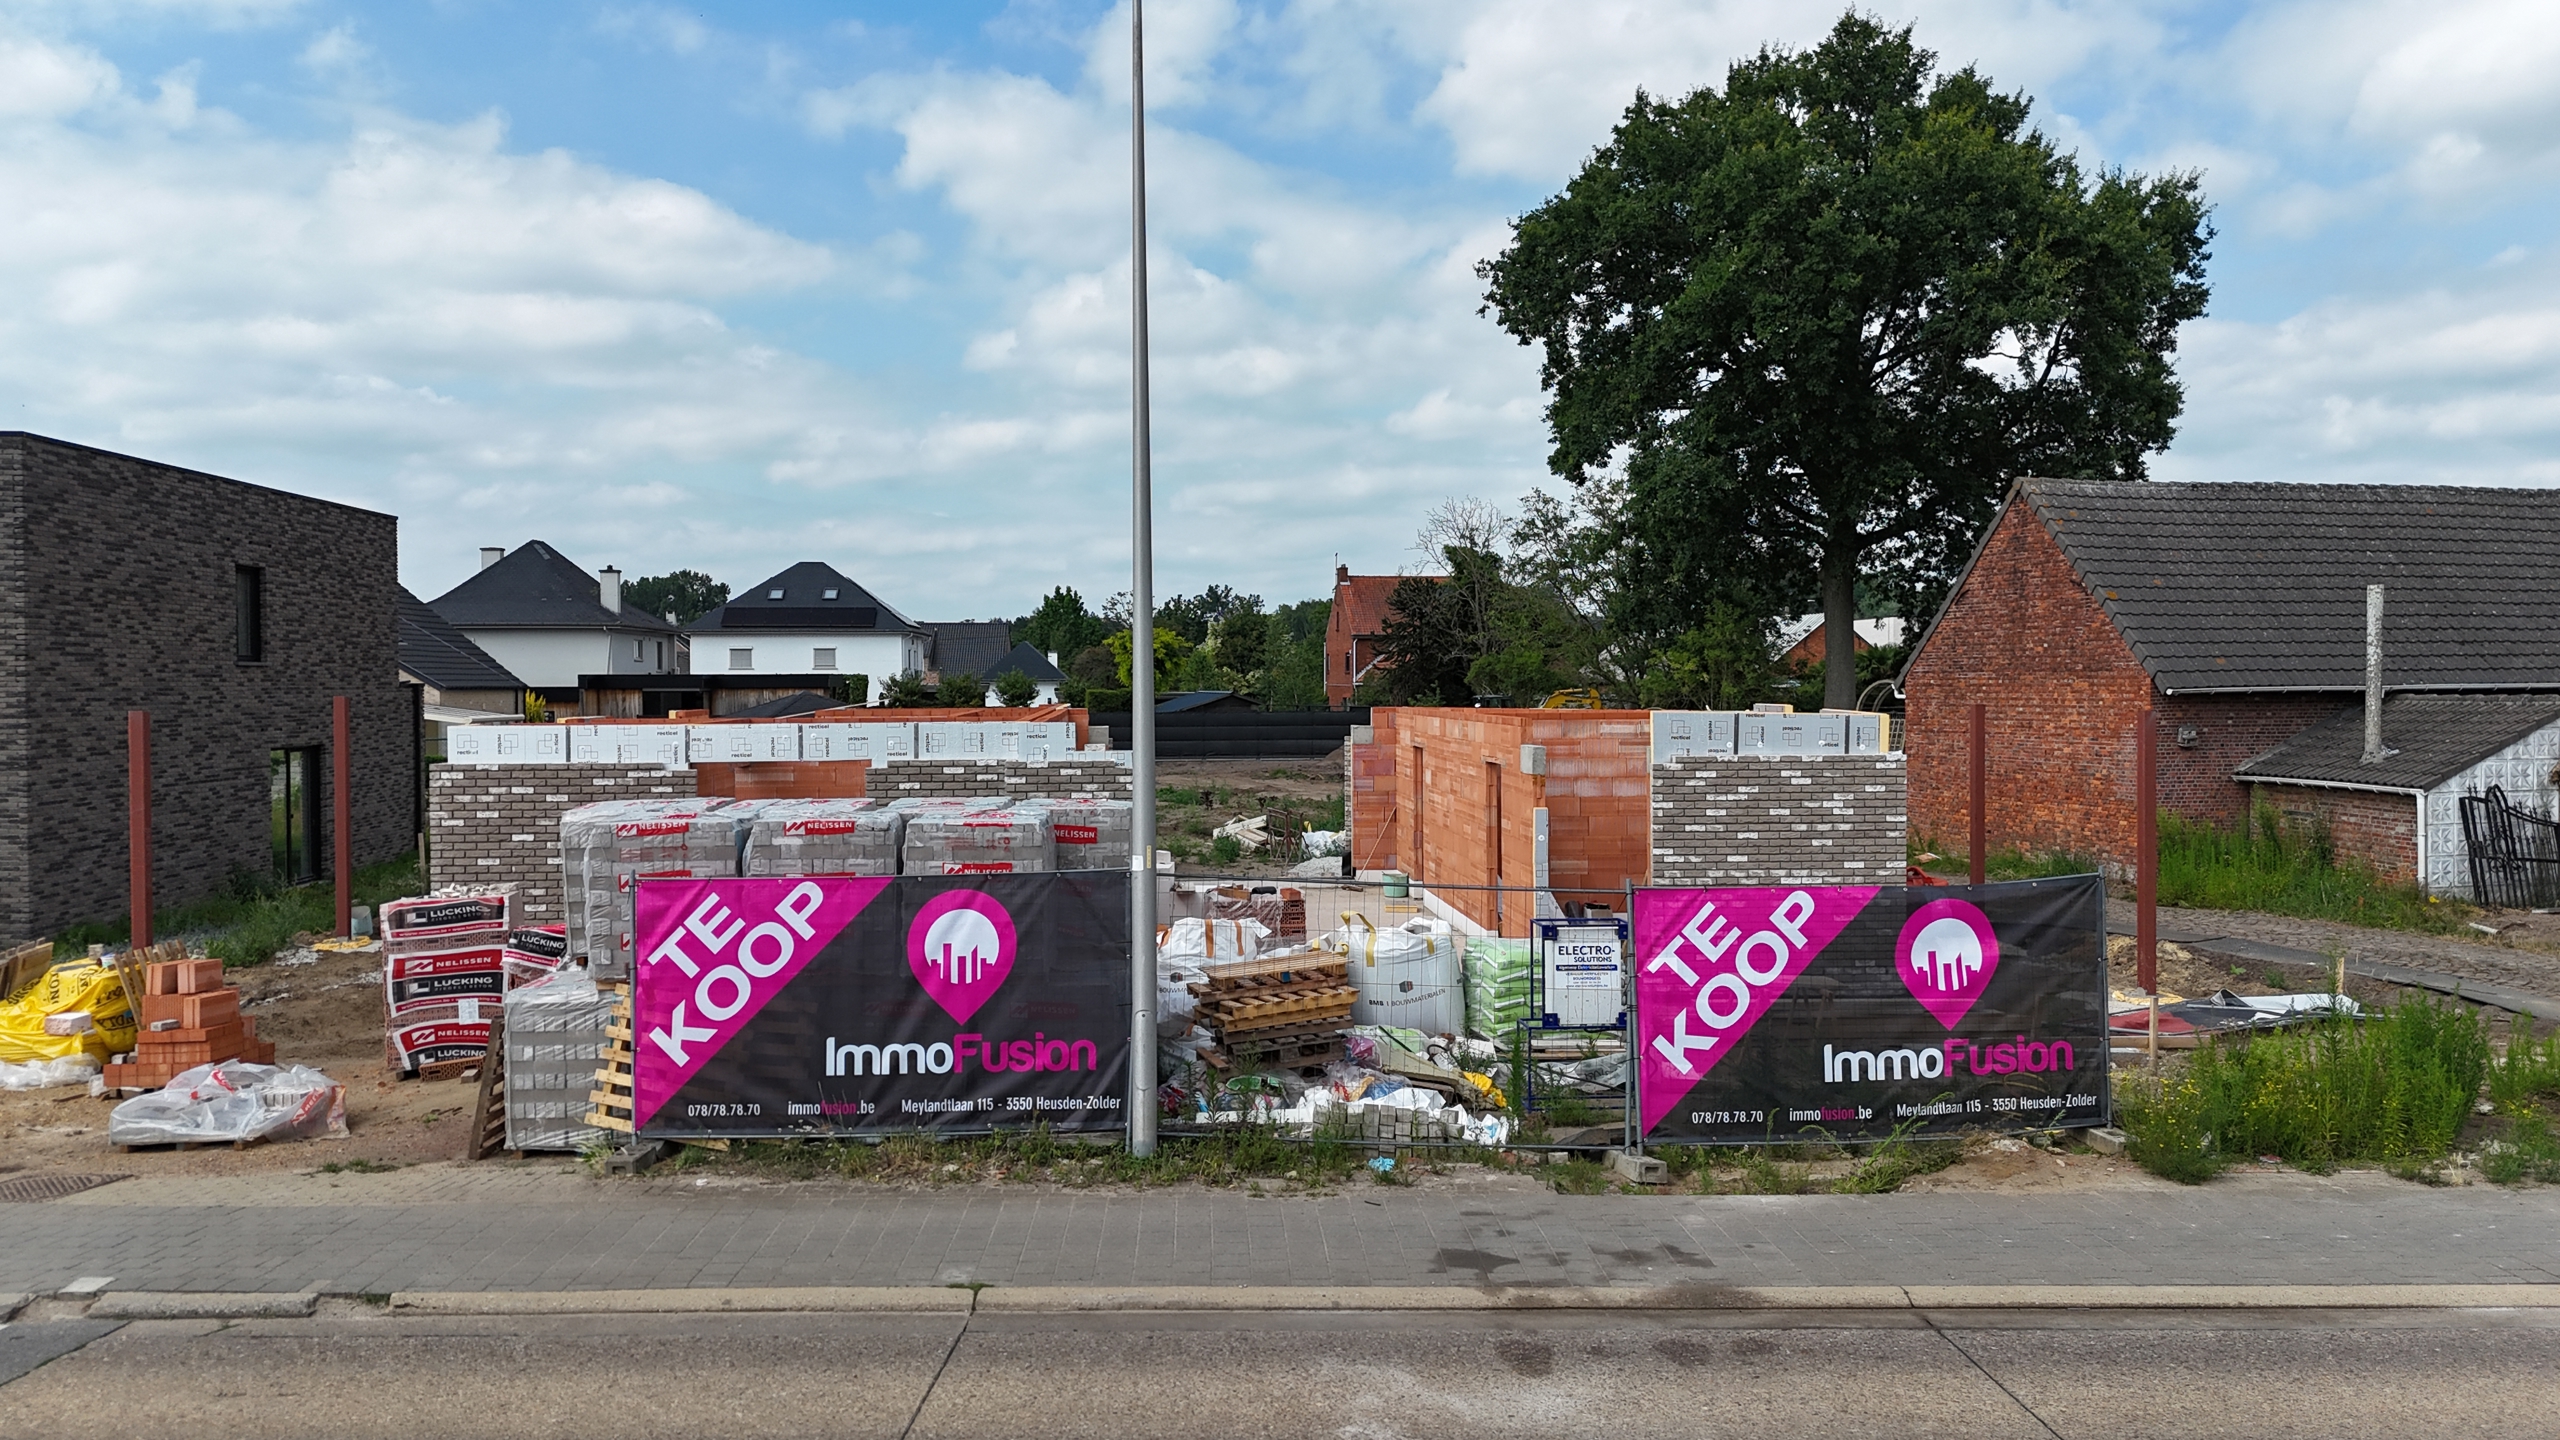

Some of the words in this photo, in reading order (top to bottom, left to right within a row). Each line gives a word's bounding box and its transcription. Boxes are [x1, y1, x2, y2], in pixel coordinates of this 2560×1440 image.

[807, 821, 852, 830] NELISSEN
[1054, 829, 1095, 839] NELISSEN
[430, 904, 491, 918] LUCKING
[521, 934, 564, 949] LUCKING
[647, 892, 746, 979] TE
[1558, 945, 1615, 956] ELECTRO-
[1646, 901, 1742, 987] TE
[436, 956, 492, 968] NELISSEN
[434, 976, 493, 988] LUCKING
[649, 881, 824, 1068] KOOP
[1651, 890, 1815, 1075] KOOP
[1392, 988, 1446, 1007] BOUWMATERIALEN
[438, 1029, 489, 1037] NELISSEN
[437, 1049, 487, 1058] LUCKING
[825, 1031, 1097, 1076] ImmoFusion
[1823, 1034, 2073, 1083] ImmoFusion
[688, 1103, 760, 1117] 078/78.78.70
[787, 1100, 875, 1116] immofusion.be
[901, 1099, 974, 1116] Meylandtlaan
[977, 1098, 993, 1111] 115
[1006, 1096, 1033, 1111] 3550
[1036, 1095, 1121, 1110] Heusden-Zolder
[1966, 1099, 1981, 1113] 115
[1992, 1098, 2017, 1111] 3550
[2020, 1093, 2097, 1110] Heusden-Zolder
[1691, 1110, 1763, 1124] 078/78.78.70
[1789, 1105, 1872, 1122] immofusion.be
